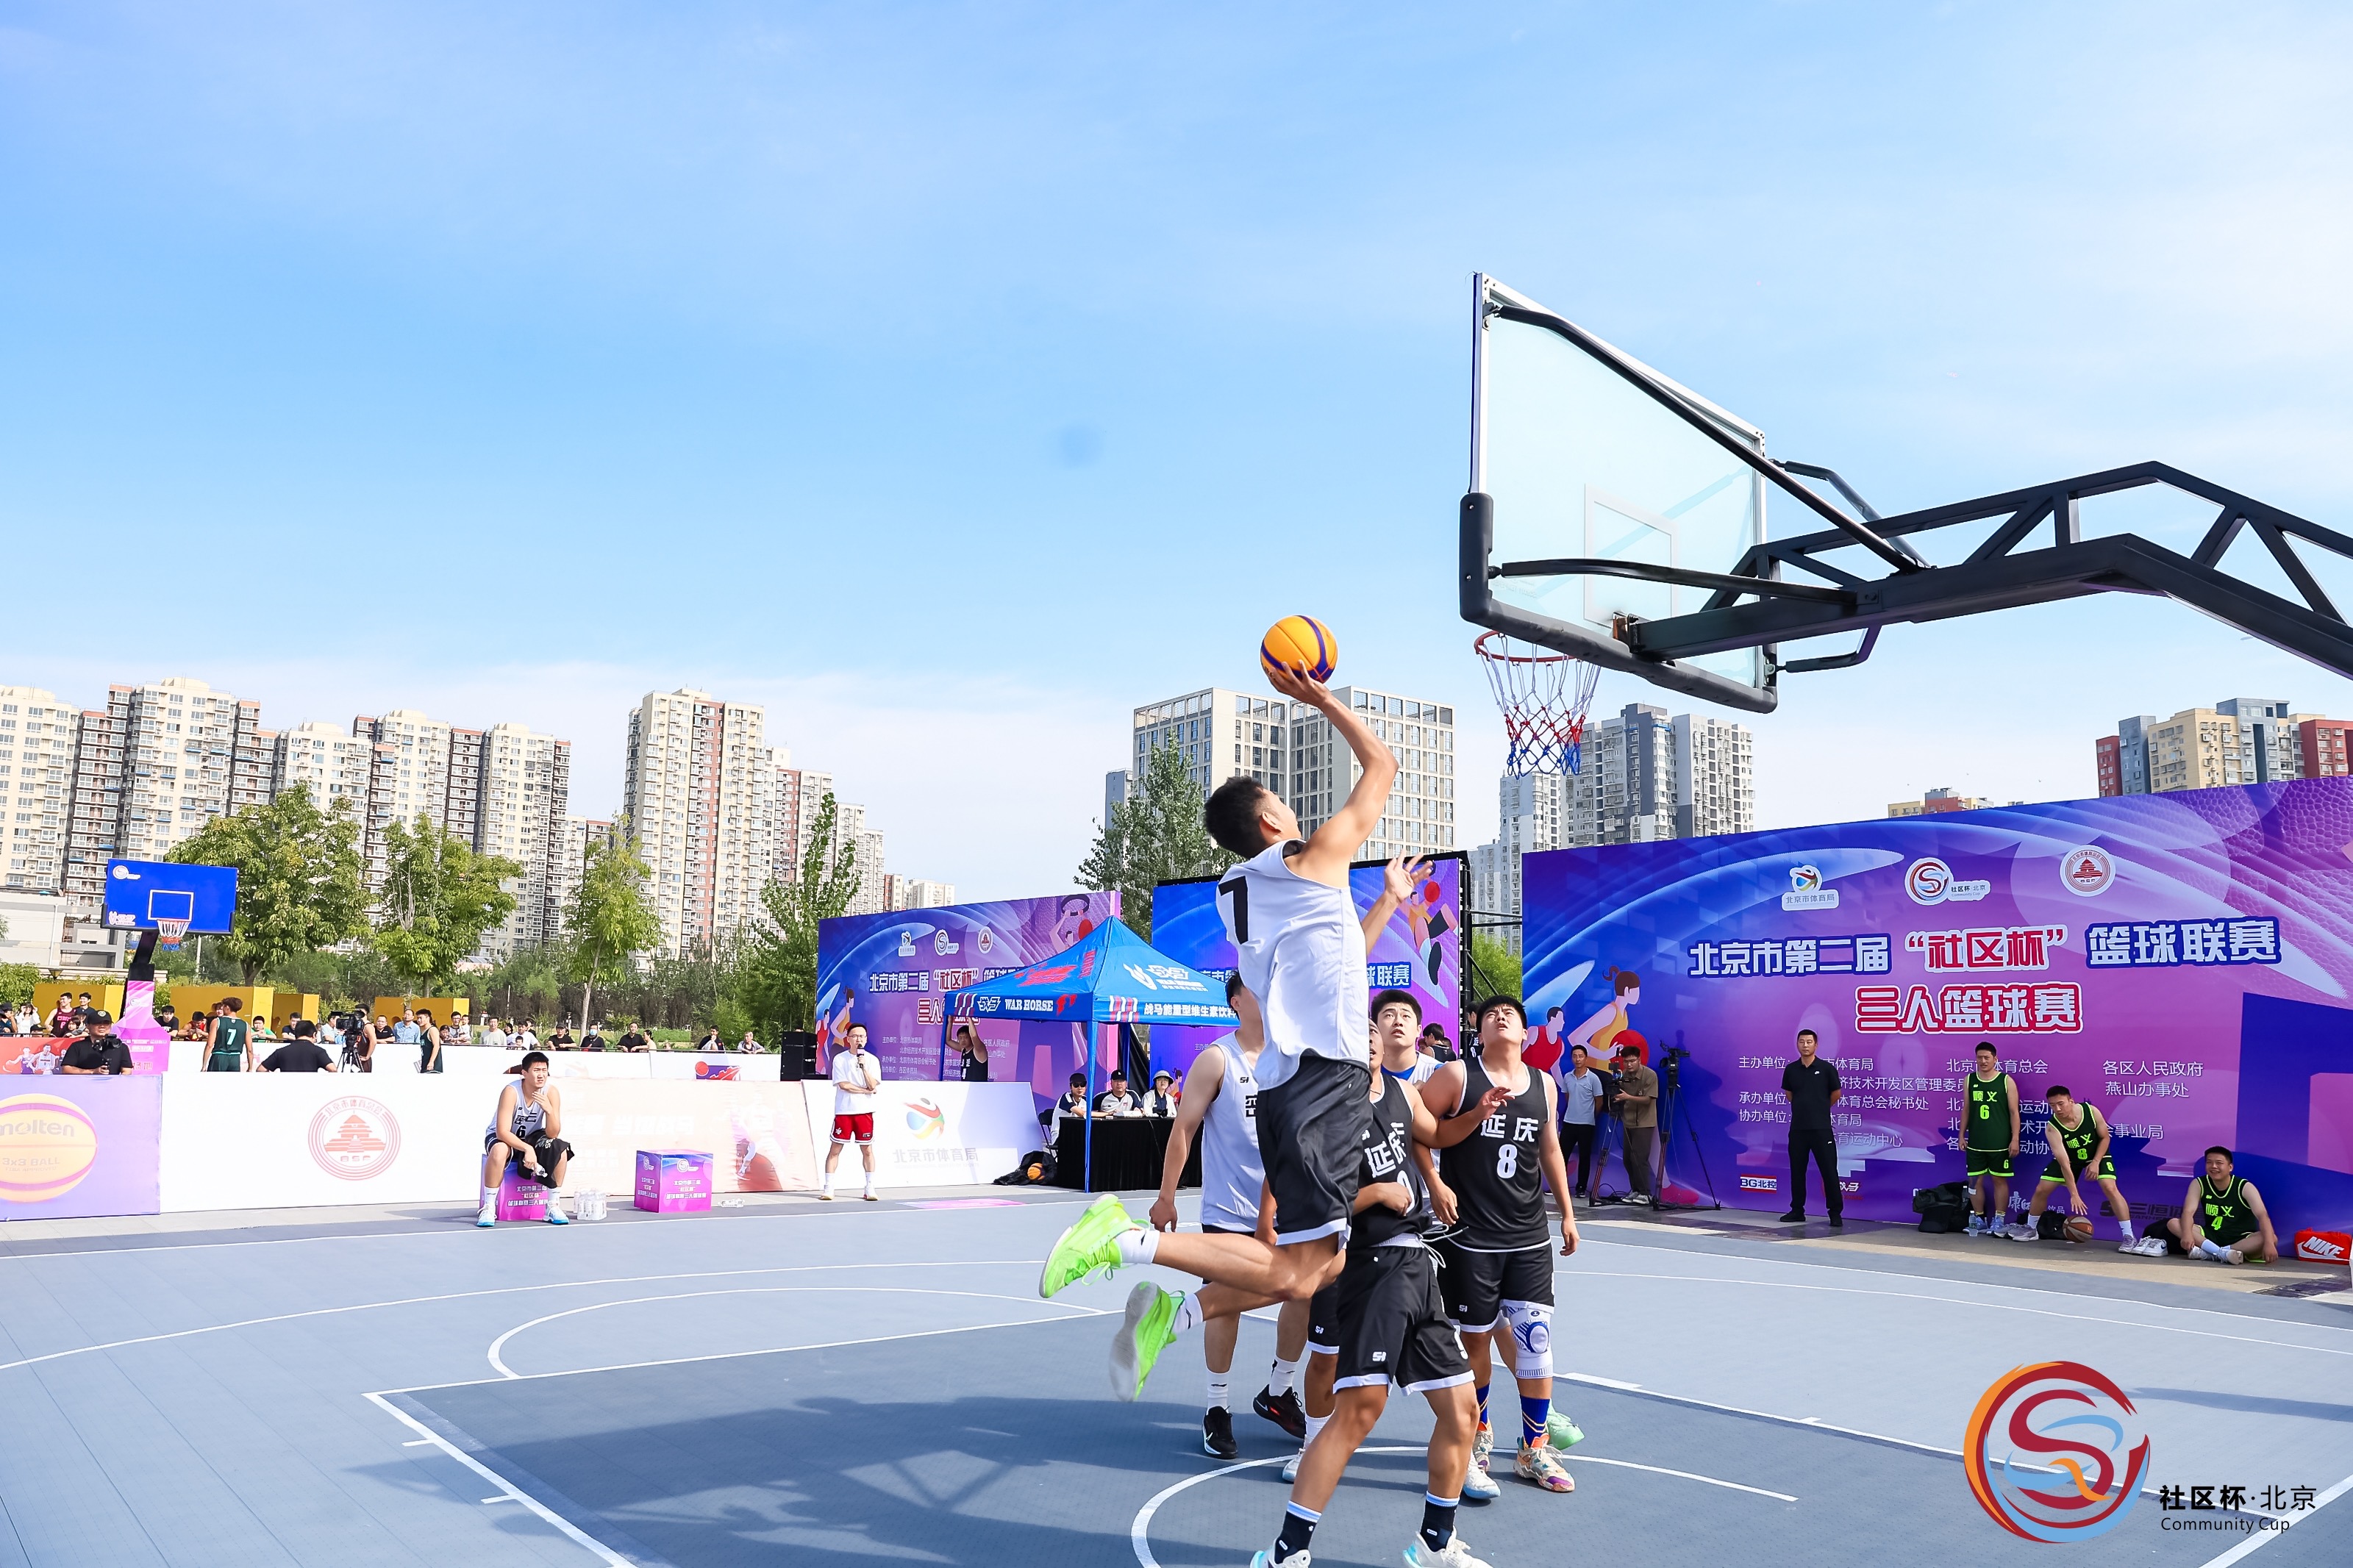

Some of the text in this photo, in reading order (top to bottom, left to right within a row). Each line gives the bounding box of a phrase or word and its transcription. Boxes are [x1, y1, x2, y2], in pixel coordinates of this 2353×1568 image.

[1785, 893, 1835, 904] 北京市体育局
[1217, 875, 1249, 945] 7
[1689, 936, 1889, 975] 北京市第二届
[2088, 920, 2277, 965] 篮球联赛
[869, 970, 929, 992] 北京市第二届
[1004, 999, 1054, 1012] WAR HORSE
[1143, 1003, 1237, 1019] 战马能量型维生素饮料
[1857, 987, 2078, 1030] 三人篮球赛
[226, 1029, 237, 1045] 7
[2102, 1061, 2204, 1077] 各区人民政府
[1973, 1091, 1998, 1103] 顺义
[2105, 1081, 2190, 1098] 燕山办事处
[1979, 1104, 1990, 1120] 6
[0, 1120, 74, 1137] molten
[515, 1125, 526, 1139] 6
[1480, 1114, 1539, 1142] 延庆
[2066, 1133, 2093, 1148] 顺义
[30, 1157, 60, 1167] BALL
[893, 1148, 979, 1164] 北京市体育局
[1496, 1144, 1518, 1179] 8
[2077, 1148, 2088, 1160] 8
[2004, 1159, 2009, 1169] 6
[2210, 1216, 2223, 1231] 4
[2302, 1236, 2345, 1257] NIKE
